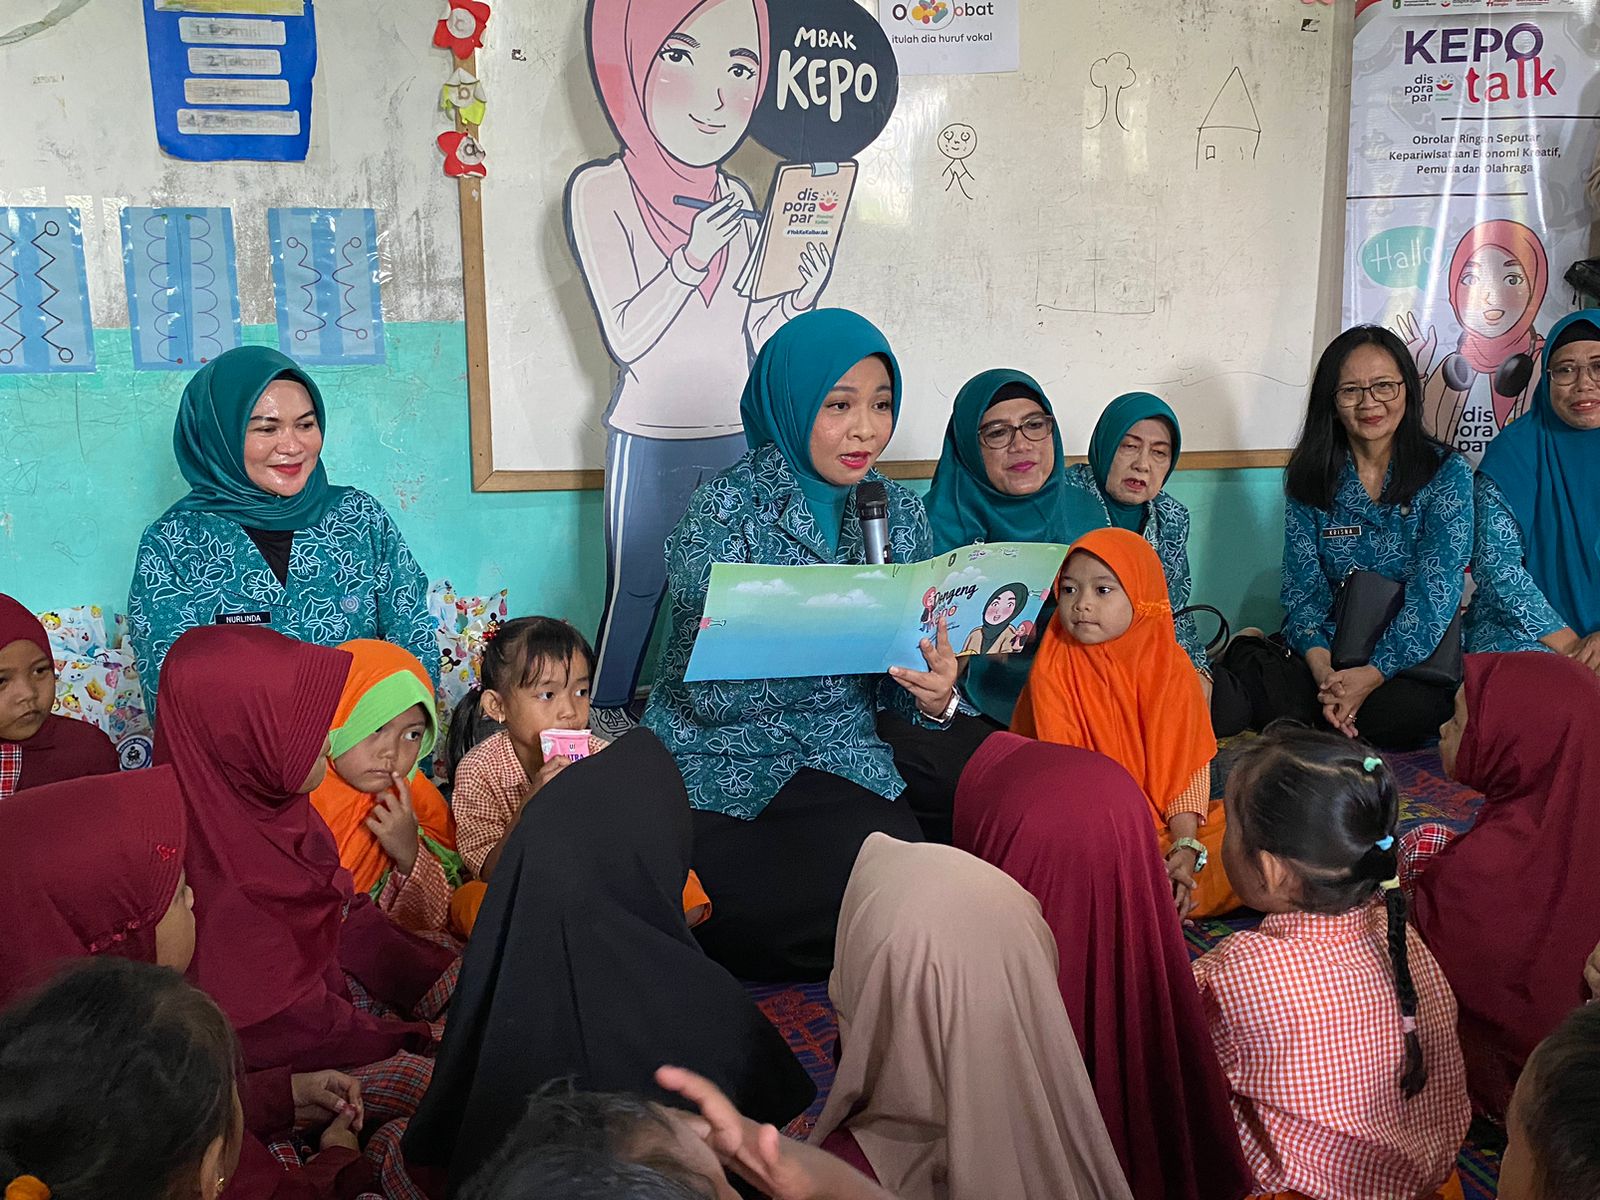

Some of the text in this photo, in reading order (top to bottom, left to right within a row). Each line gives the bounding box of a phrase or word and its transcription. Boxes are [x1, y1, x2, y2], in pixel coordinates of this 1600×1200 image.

[954, 2, 995, 16] obat
[794, 26, 857, 51] MBAK
[891, 32, 993, 43] itulah dia huruf vokal
[1404, 22, 1544, 65] KEPO
[1414, 73, 1433, 84] dis
[1465, 56, 1557, 103] talk
[777, 49, 878, 122] KEPO
[1404, 85, 1433, 96] pora
[1412, 94, 1433, 104] par
[1412, 134, 1456, 145] Obrolan
[1389, 149, 1470, 162] Kepariwisatan
[1473, 148, 1520, 158] Eonomi
[1416, 165, 1460, 174] Pemua
[1462, 164, 1480, 174] dan
[797, 187, 819, 201] dis
[782, 201, 816, 215] pora
[788, 213, 814, 226] par
[1462, 406, 1494, 423] dis
[1455, 425, 1494, 438] ora
[1458, 440, 1488, 453] pa
[226, 614, 262, 624] NURLINDA
